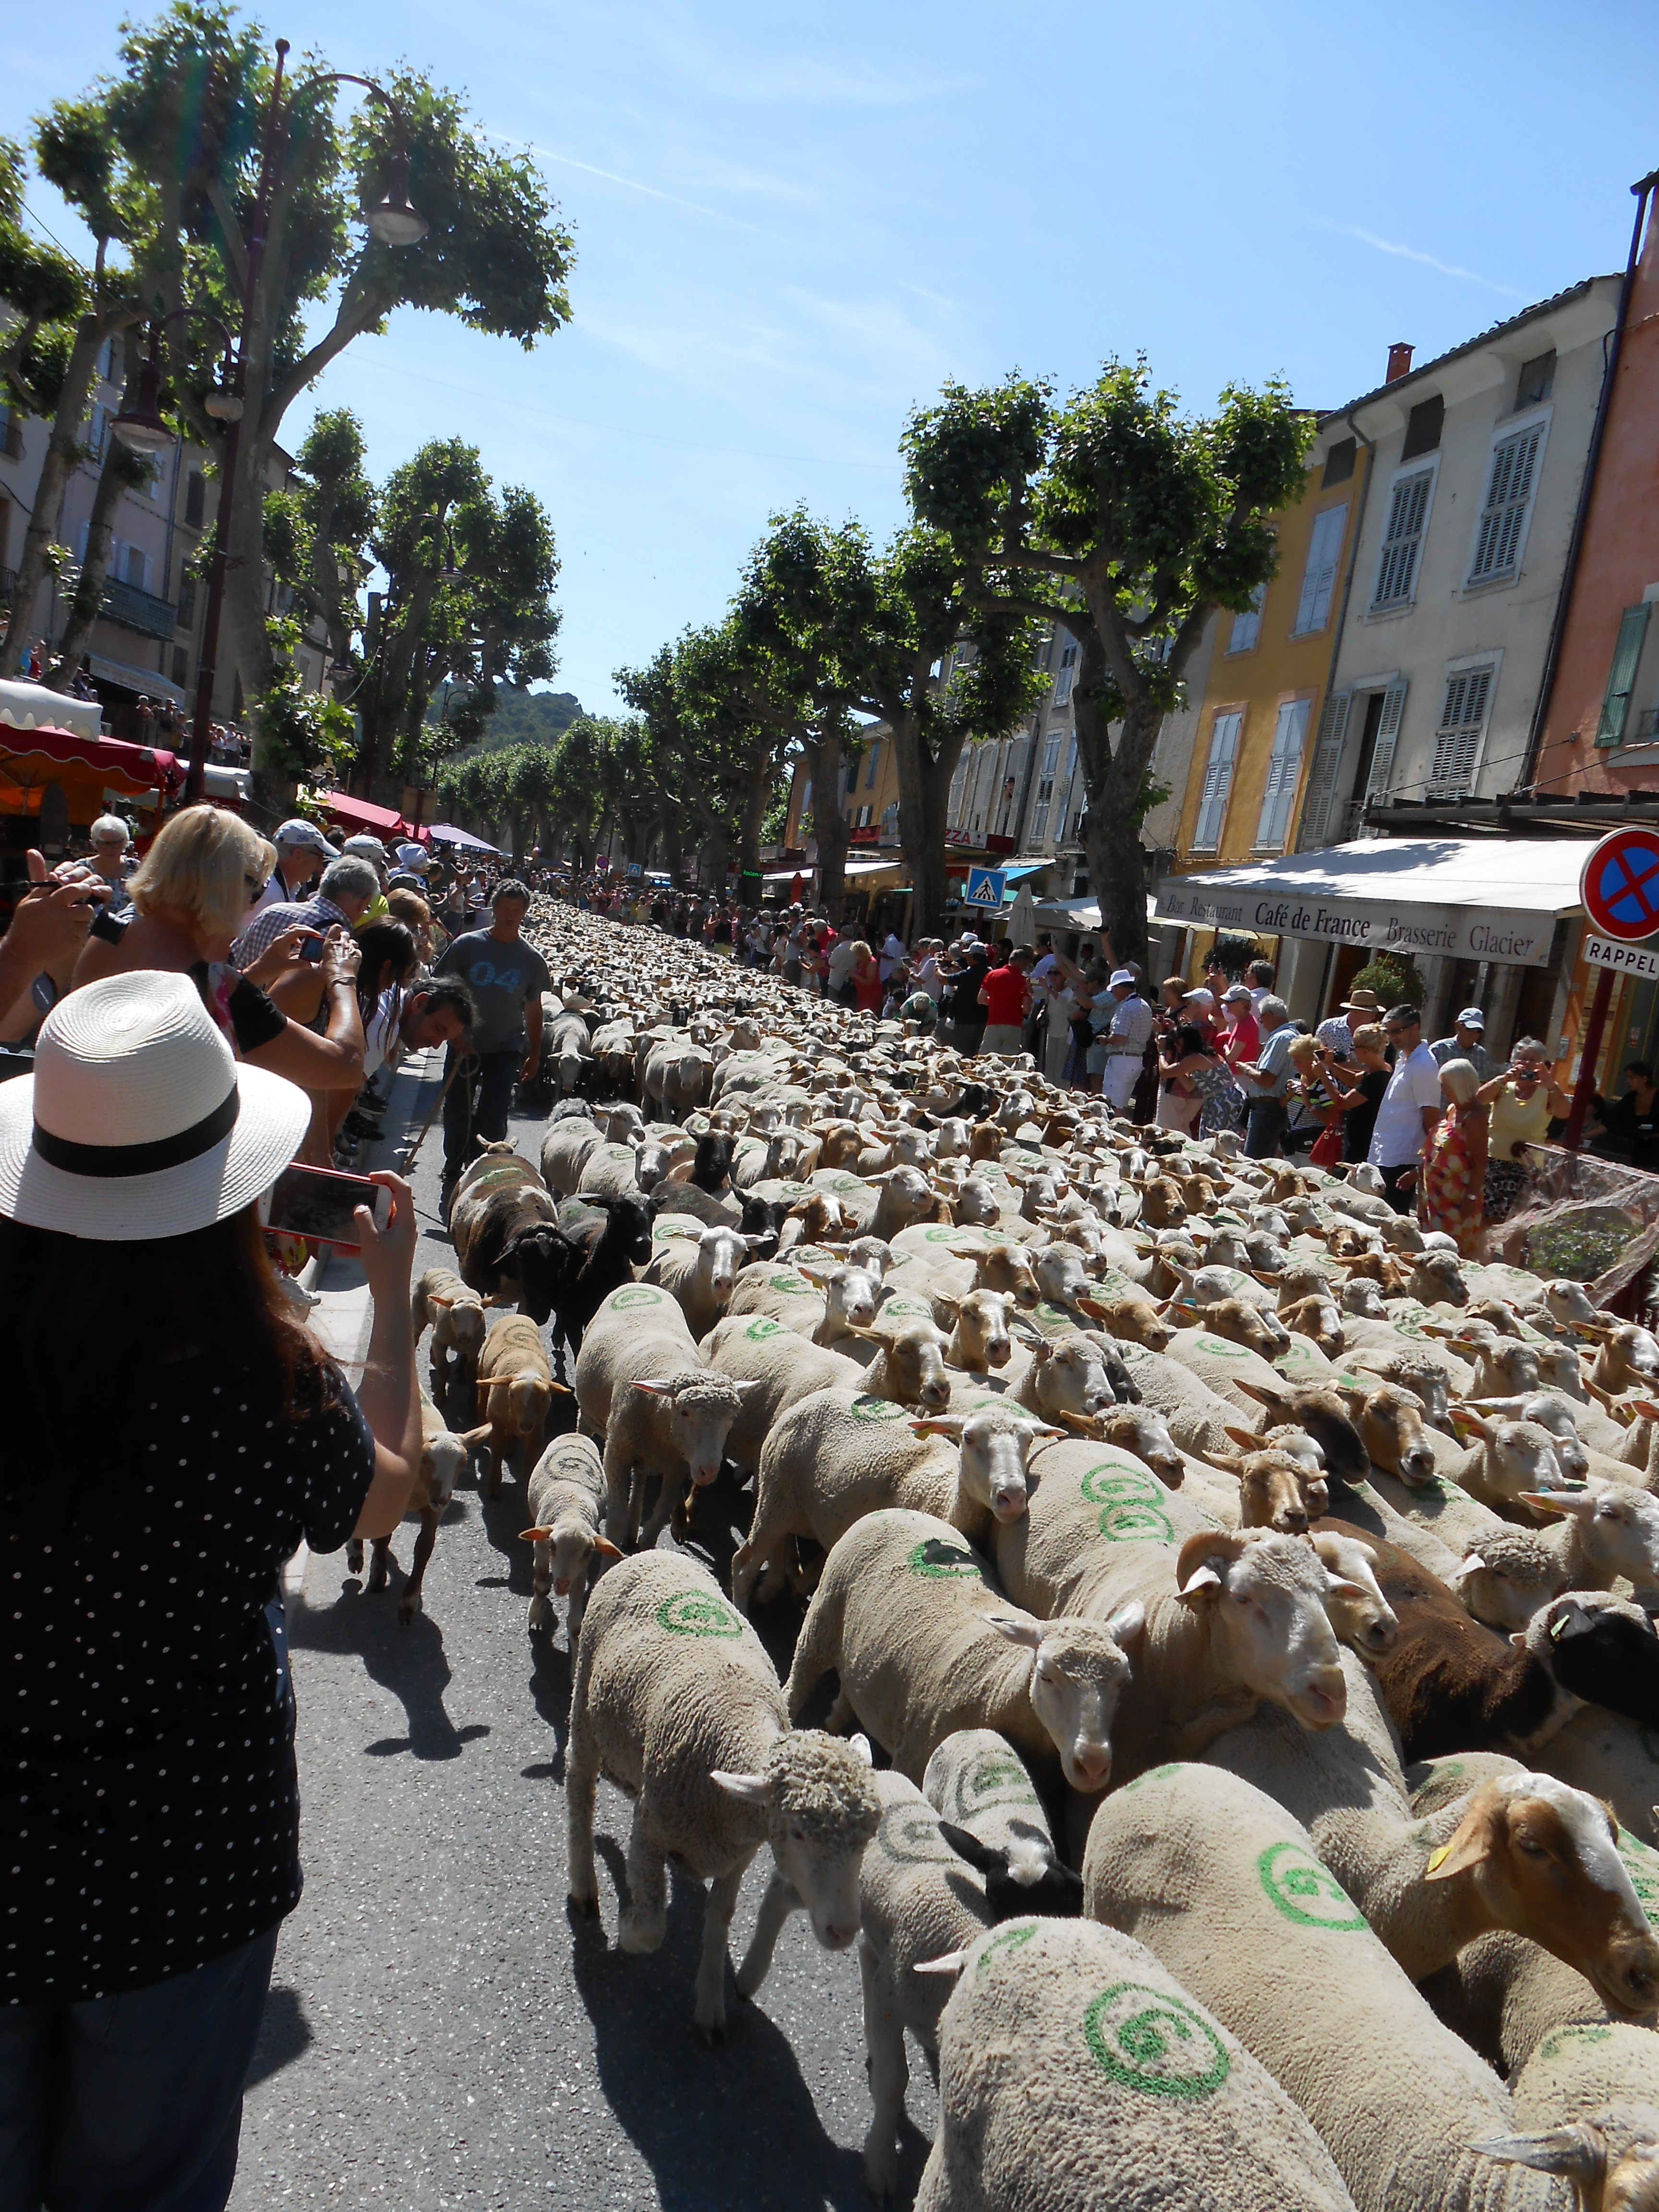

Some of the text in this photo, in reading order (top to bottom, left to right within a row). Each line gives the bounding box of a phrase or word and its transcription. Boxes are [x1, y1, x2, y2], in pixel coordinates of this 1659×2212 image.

[1167, 894, 1534, 956] Bar Restaurant Café de France Brasserie Glacier
[1589, 942, 1656, 974] RAPPEL
[470, 962, 521, 994] 04
